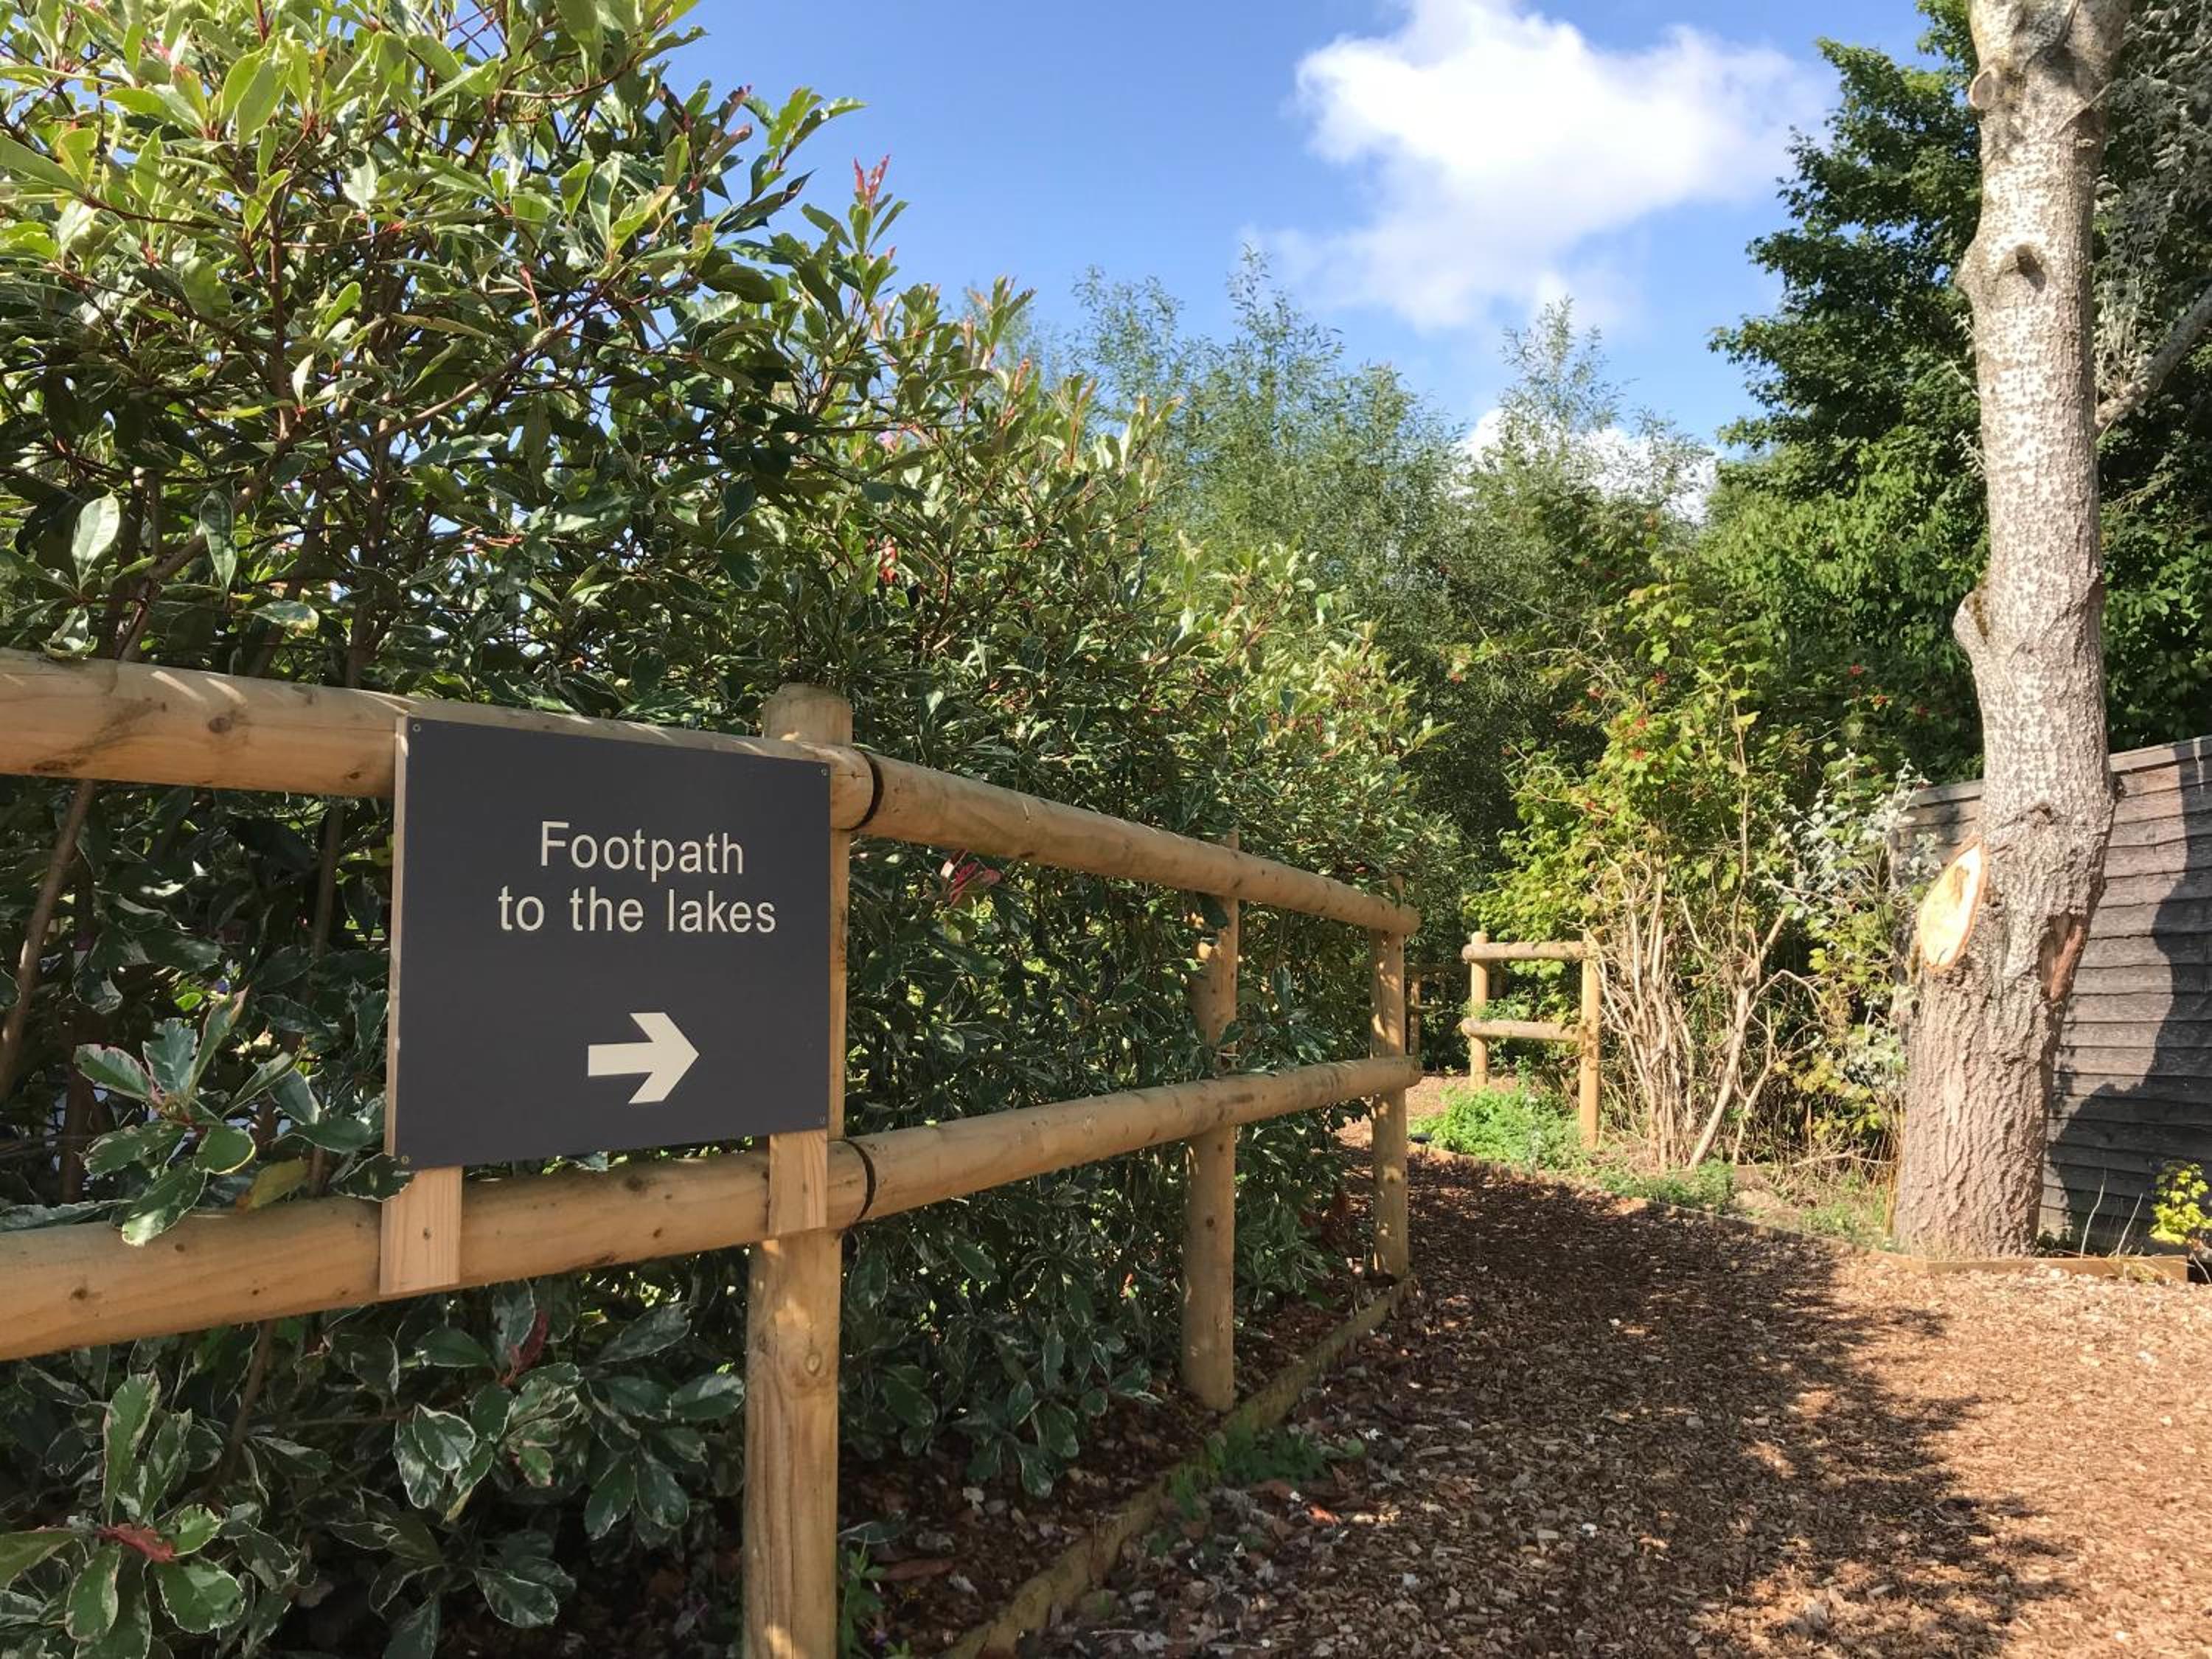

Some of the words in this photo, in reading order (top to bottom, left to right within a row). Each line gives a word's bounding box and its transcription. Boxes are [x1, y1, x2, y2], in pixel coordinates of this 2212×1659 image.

[540, 821, 744, 883] Footpath
[498, 886, 545, 932] to
[570, 886, 644, 933] the
[668, 888, 776, 933] lakes
